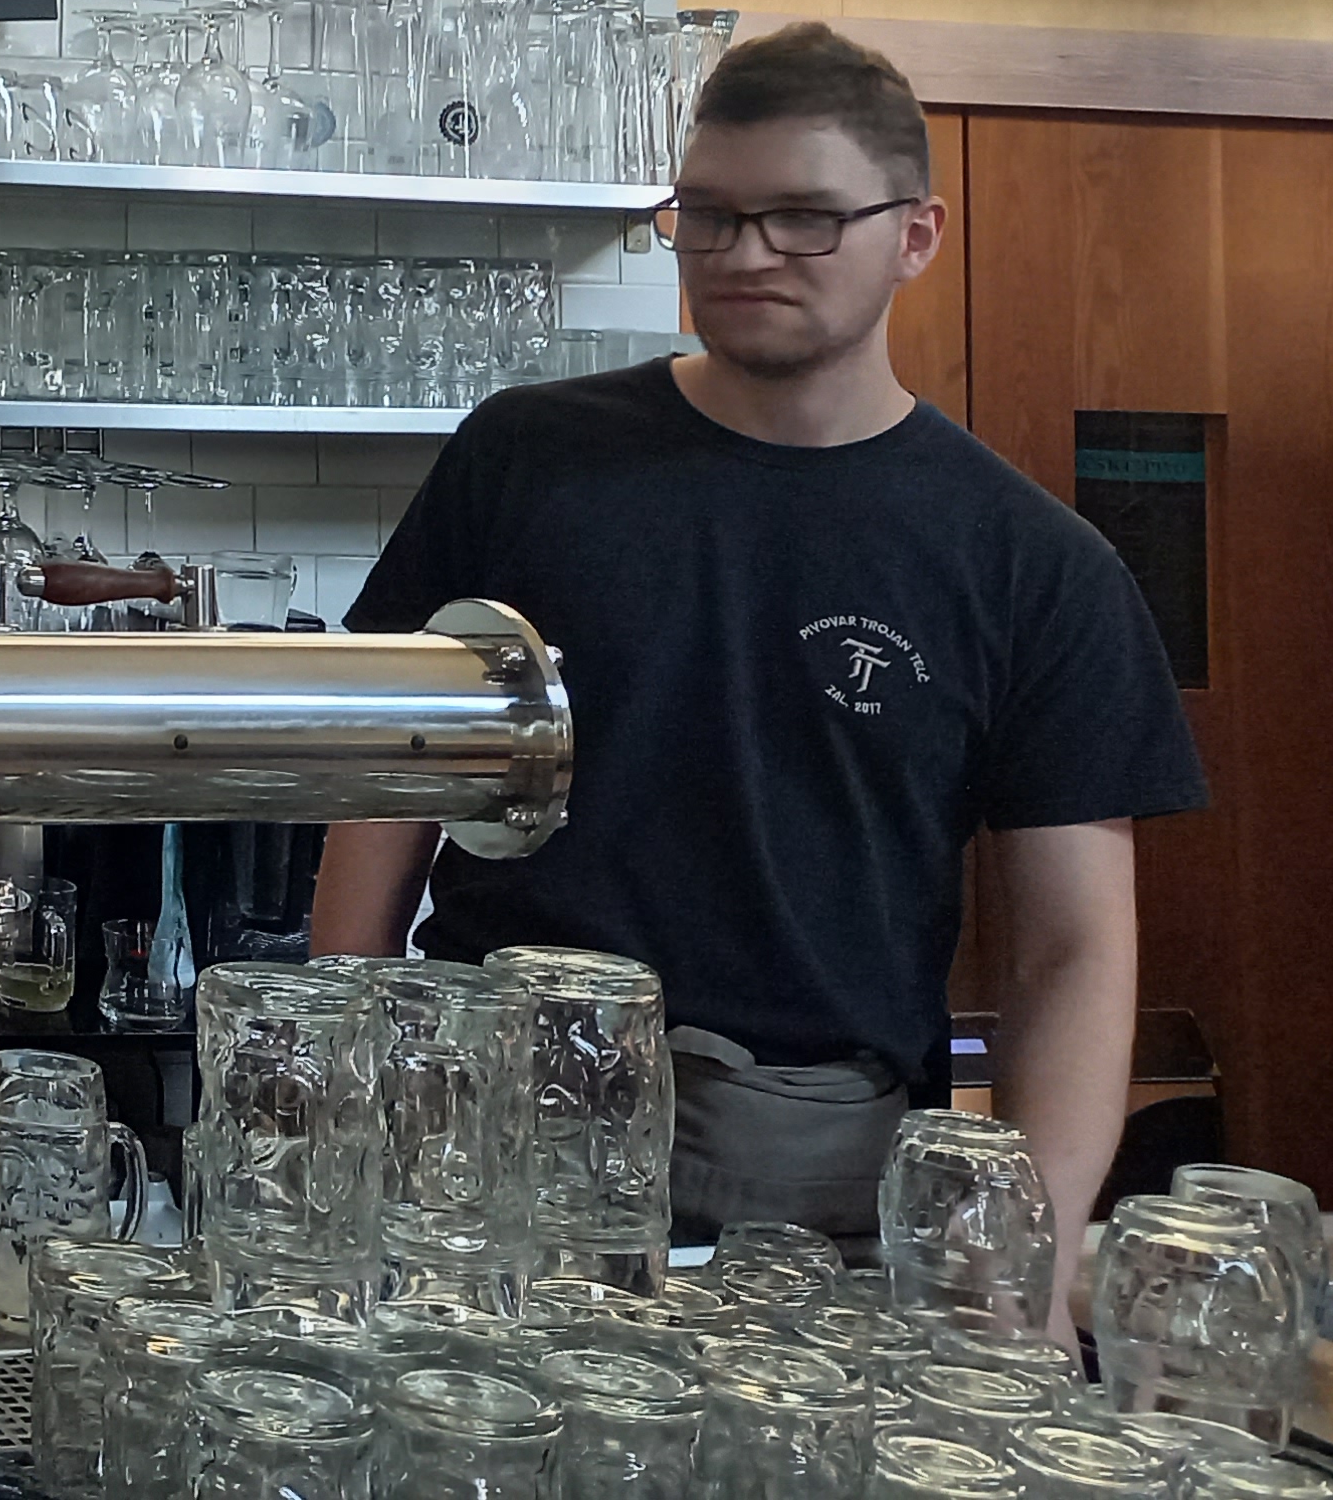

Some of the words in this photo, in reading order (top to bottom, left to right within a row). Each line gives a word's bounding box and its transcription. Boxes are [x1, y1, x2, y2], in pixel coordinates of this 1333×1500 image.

[799, 615, 857, 640] PIVOVAR
[860, 617, 912, 651] TROJAN
[909, 652, 930, 682] TELČ
[855, 702, 881, 715] 2017
